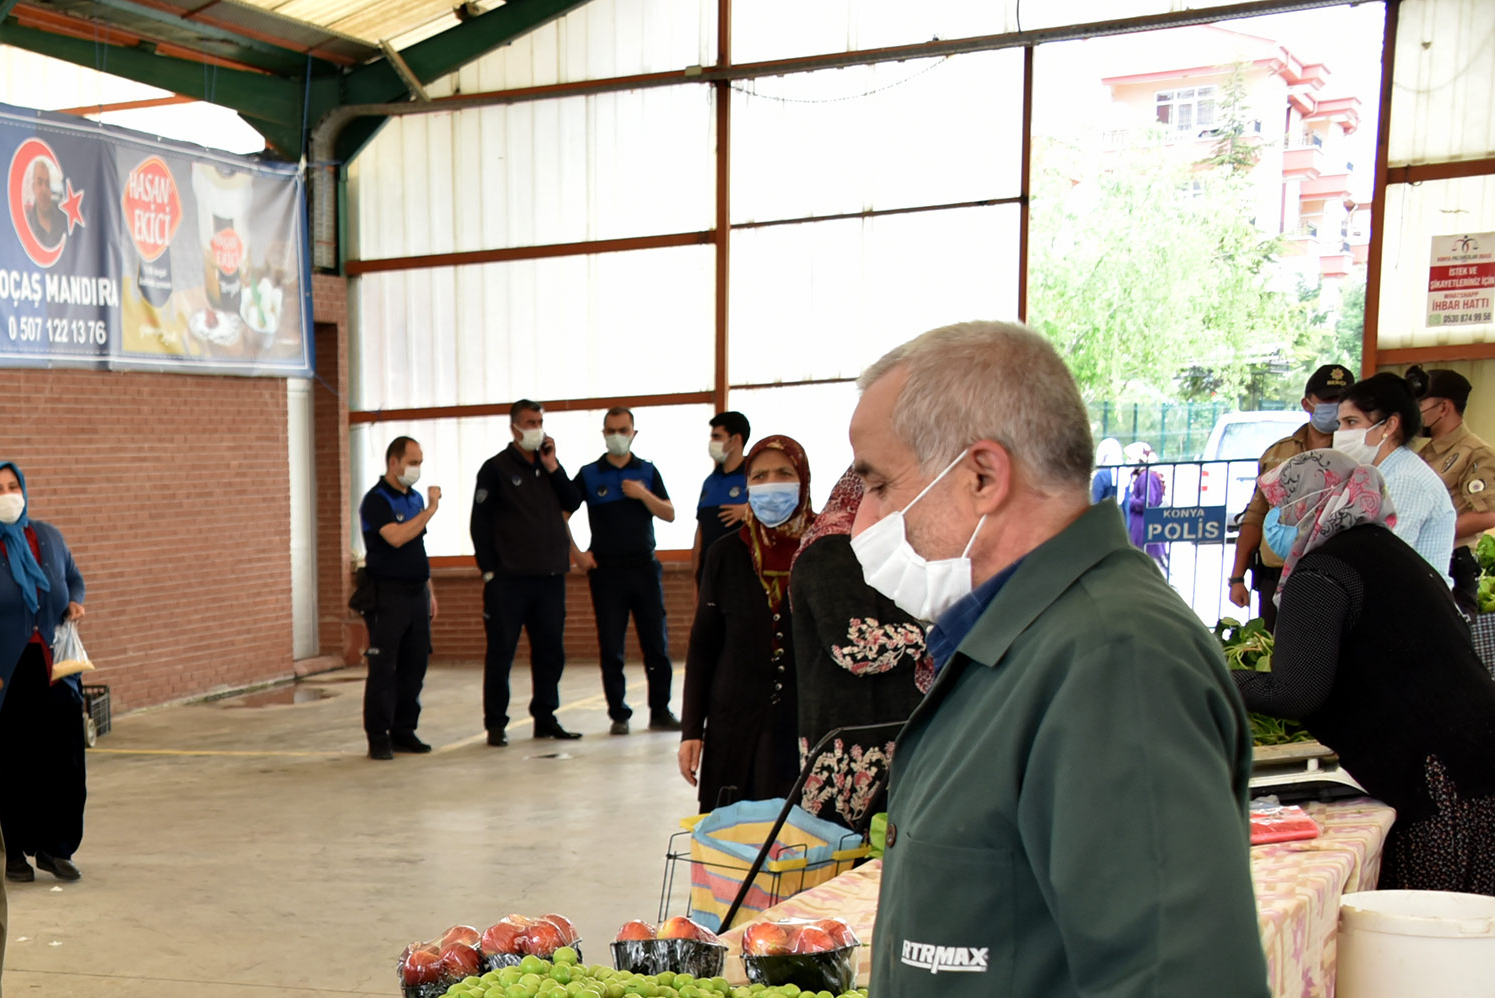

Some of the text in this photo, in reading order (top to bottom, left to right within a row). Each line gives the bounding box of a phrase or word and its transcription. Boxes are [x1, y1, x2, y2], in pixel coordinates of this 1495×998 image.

[129, 171, 170, 204] HASAN
[134, 205, 172, 246] EKİCİ
[45, 273, 119, 307] MANDIRA
[1432, 298, 1489, 312] İHBAR HATTI
[8, 315, 107, 345] 0 507 122 13 76
[1147, 518, 1220, 540] POLİS
[1163, 509, 1205, 518] KONYA
[902, 940, 989, 974] RTRMAX
